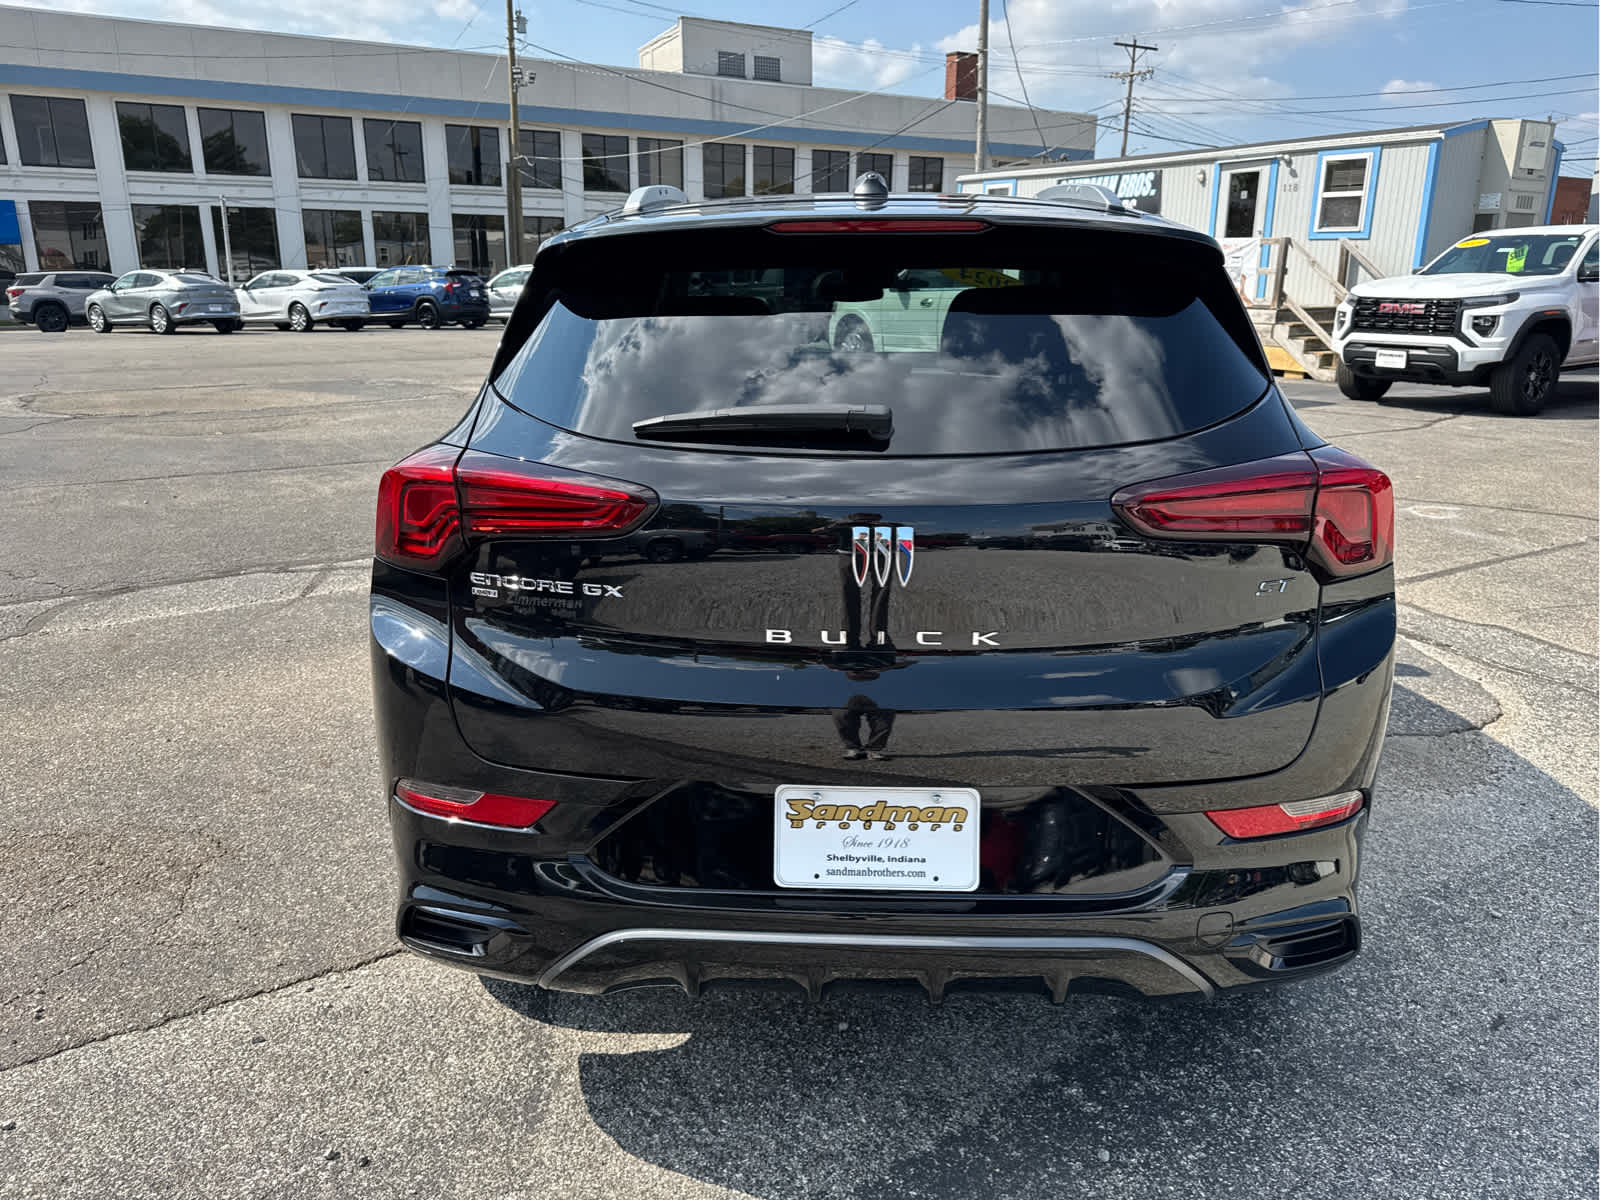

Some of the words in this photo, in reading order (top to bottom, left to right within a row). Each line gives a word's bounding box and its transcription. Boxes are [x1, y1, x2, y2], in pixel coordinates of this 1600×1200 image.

[1117, 171, 1157, 198] BROS.
[1378, 303, 1426, 315] GMC
[470, 571, 574, 594] ENCORE
[582, 583, 624, 598] GX
[1256, 576, 1296, 596] ST
[765, 629, 1001, 646] BUICK
[786, 799, 968, 824] Sandman
[791, 819, 963, 832] Brothers
[842, 834, 874, 849] Since
[876, 837, 911, 849] 1918
[826, 854, 885, 864] Shelbyville,
[887, 855, 927, 864] Indiana
[826, 867, 927, 878] sandmanbrothers.com
